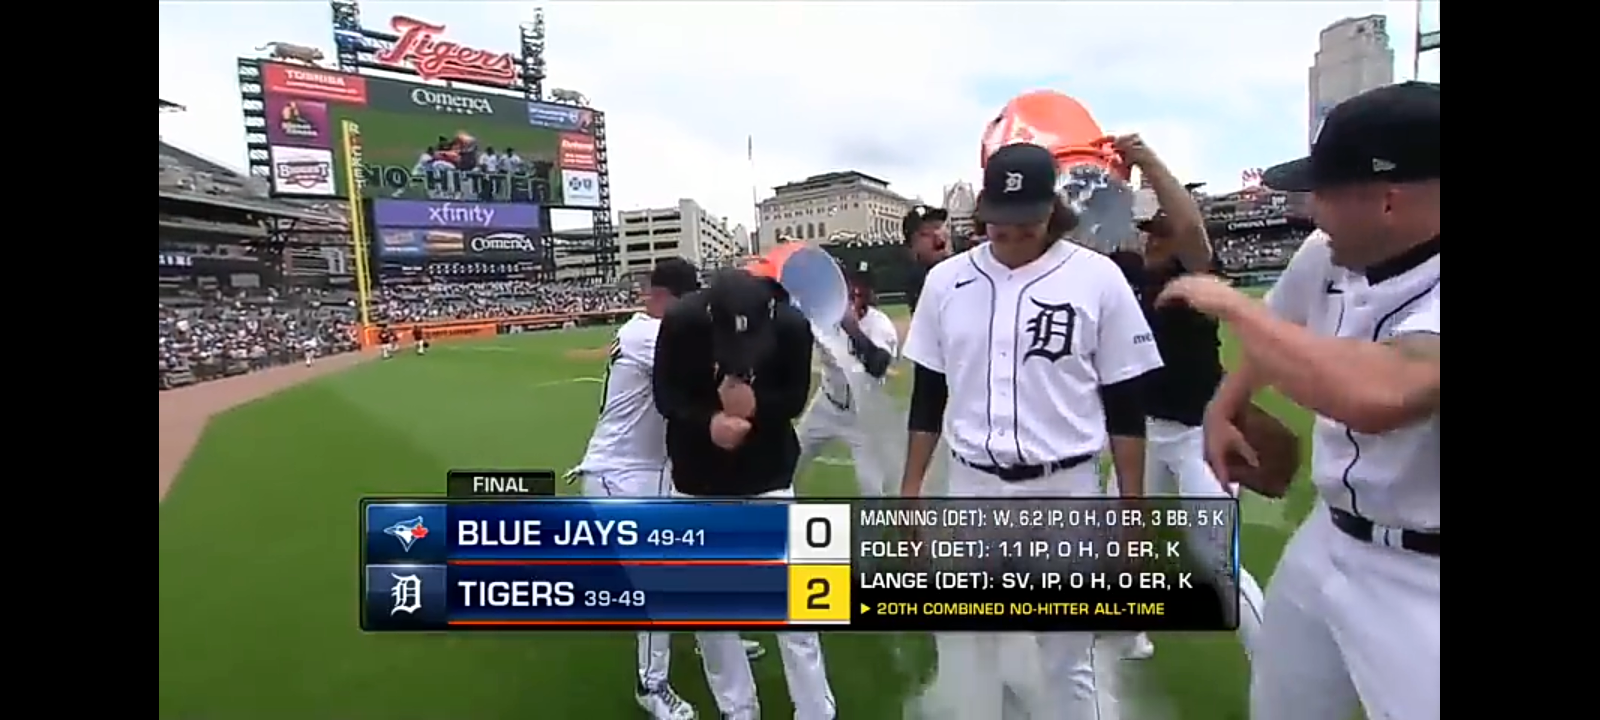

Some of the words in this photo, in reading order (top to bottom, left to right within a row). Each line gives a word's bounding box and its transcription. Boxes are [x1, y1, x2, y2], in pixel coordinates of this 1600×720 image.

[376, 15, 517, 87] Tigers
[284, 69, 346, 87] TOSHIBA
[429, 202, 495, 226] xfinity
